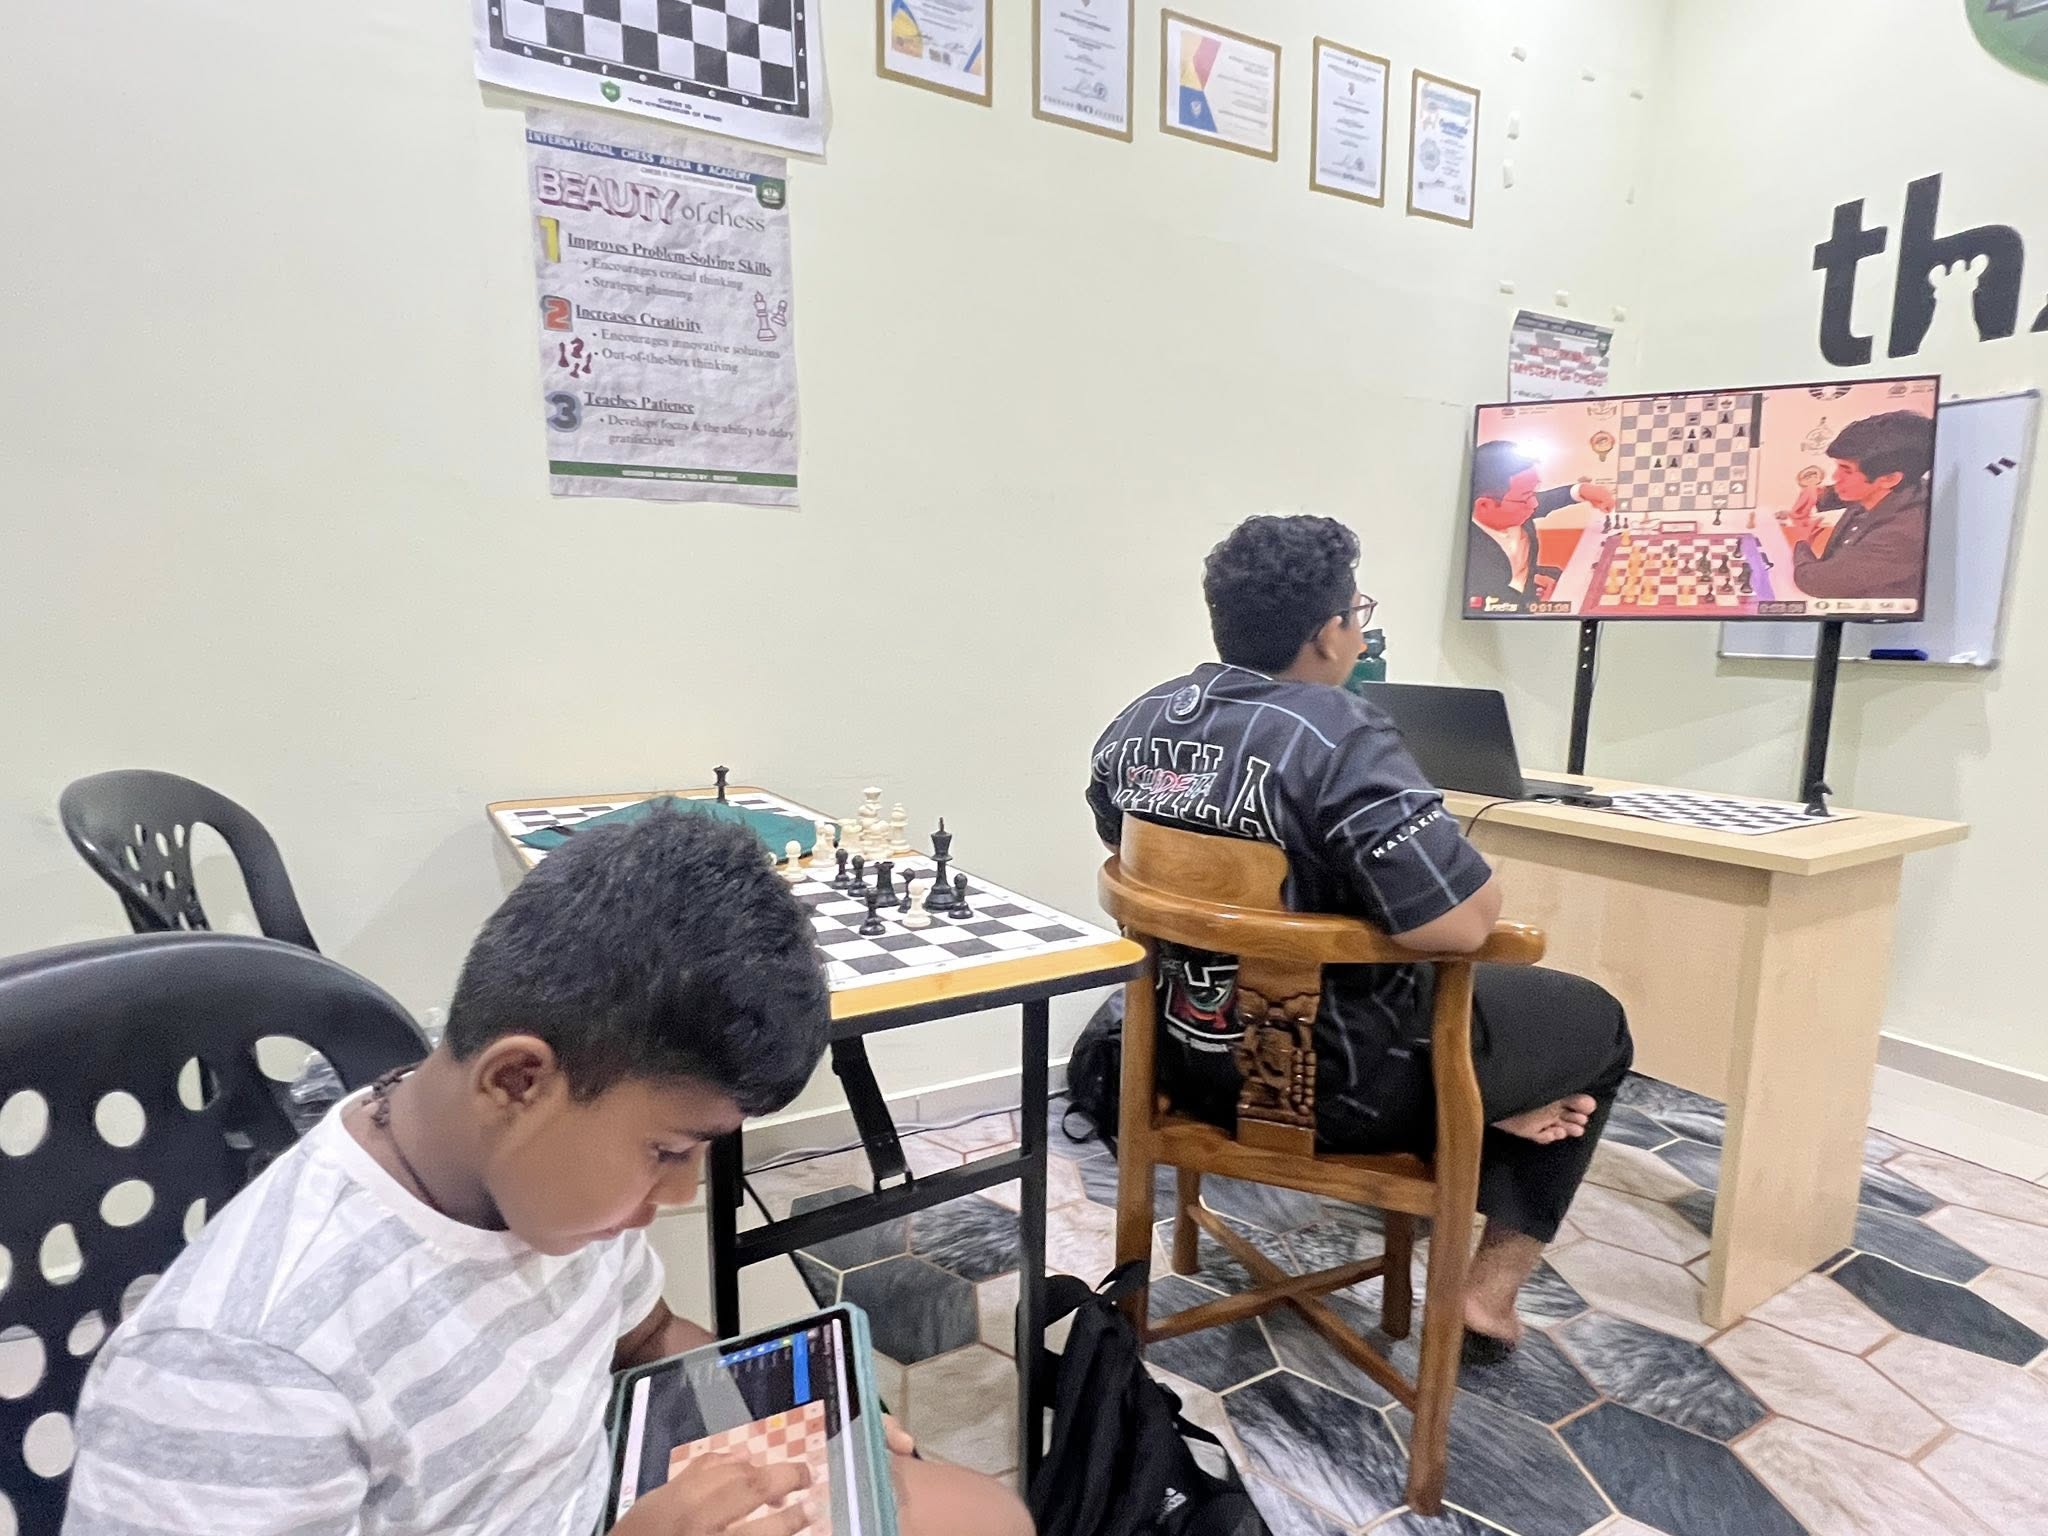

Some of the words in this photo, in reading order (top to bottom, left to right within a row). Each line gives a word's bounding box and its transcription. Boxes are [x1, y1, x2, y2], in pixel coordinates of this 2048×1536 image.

[527, 130, 615, 156] INTERNATIONAL
[621, 149, 654, 163] CHESS
[659, 155, 691, 170] ARENA
[696, 162, 704, 173] &
[708, 165, 751, 182] ACADEMY
[536, 166, 681, 226] BEAUTY
[683, 201, 704, 222] of
[706, 204, 766, 233] chess
[537, 215, 561, 264] 1
[567, 233, 630, 256] Improves
[632, 241, 736, 272] Problem-Solving
[737, 257, 773, 277] Skills
[592, 258, 657, 279] Encourages
[660, 265, 697, 283] critical
[699, 270, 744, 290] thinking
[592, 276, 644, 297] Strategic
[646, 281, 693, 301] planning
[540, 295, 573, 332] 2
[576, 304, 638, 325] Increases
[640, 312, 704, 334] Creativity
[602, 330, 669, 349] Encourages
[672, 338, 730, 355] innovative
[732, 344, 781, 360] solutions
[602, 348, 689, 369] Out-of-the-box
[692, 355, 739, 375] thinking
[544, 391, 582, 432] 3
[584, 391, 638, 410] Teaches
[640, 396, 696, 415] Patience
[703, 422, 720, 435] the
[721, 423, 753, 440] ability
[755, 426, 766, 437] to
